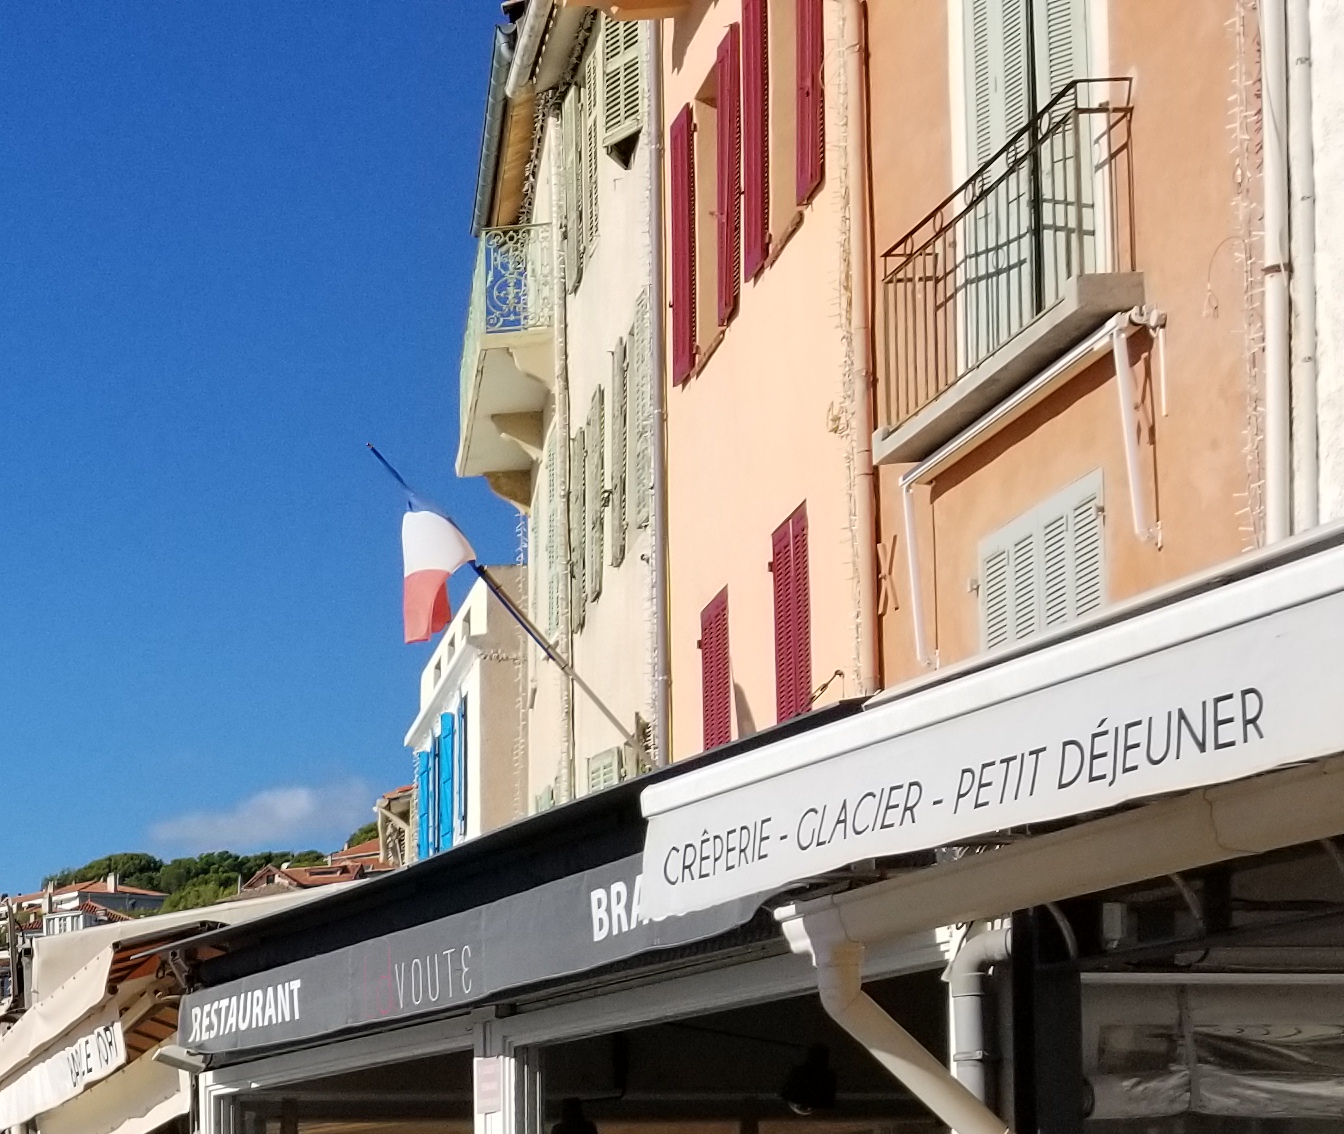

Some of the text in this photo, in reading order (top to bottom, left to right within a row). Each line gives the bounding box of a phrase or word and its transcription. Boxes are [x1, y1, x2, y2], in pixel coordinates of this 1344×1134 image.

[663, 816, 772, 887] CRÊPERIE
[796, 780, 923, 852] GLACIER
[953, 746, 1047, 815] PETIT
[1057, 687, 1265, 790] DÉJEUNER
[188, 978, 302, 1043] RESTAURANT
[394, 945, 473, 1009] VOUTE
